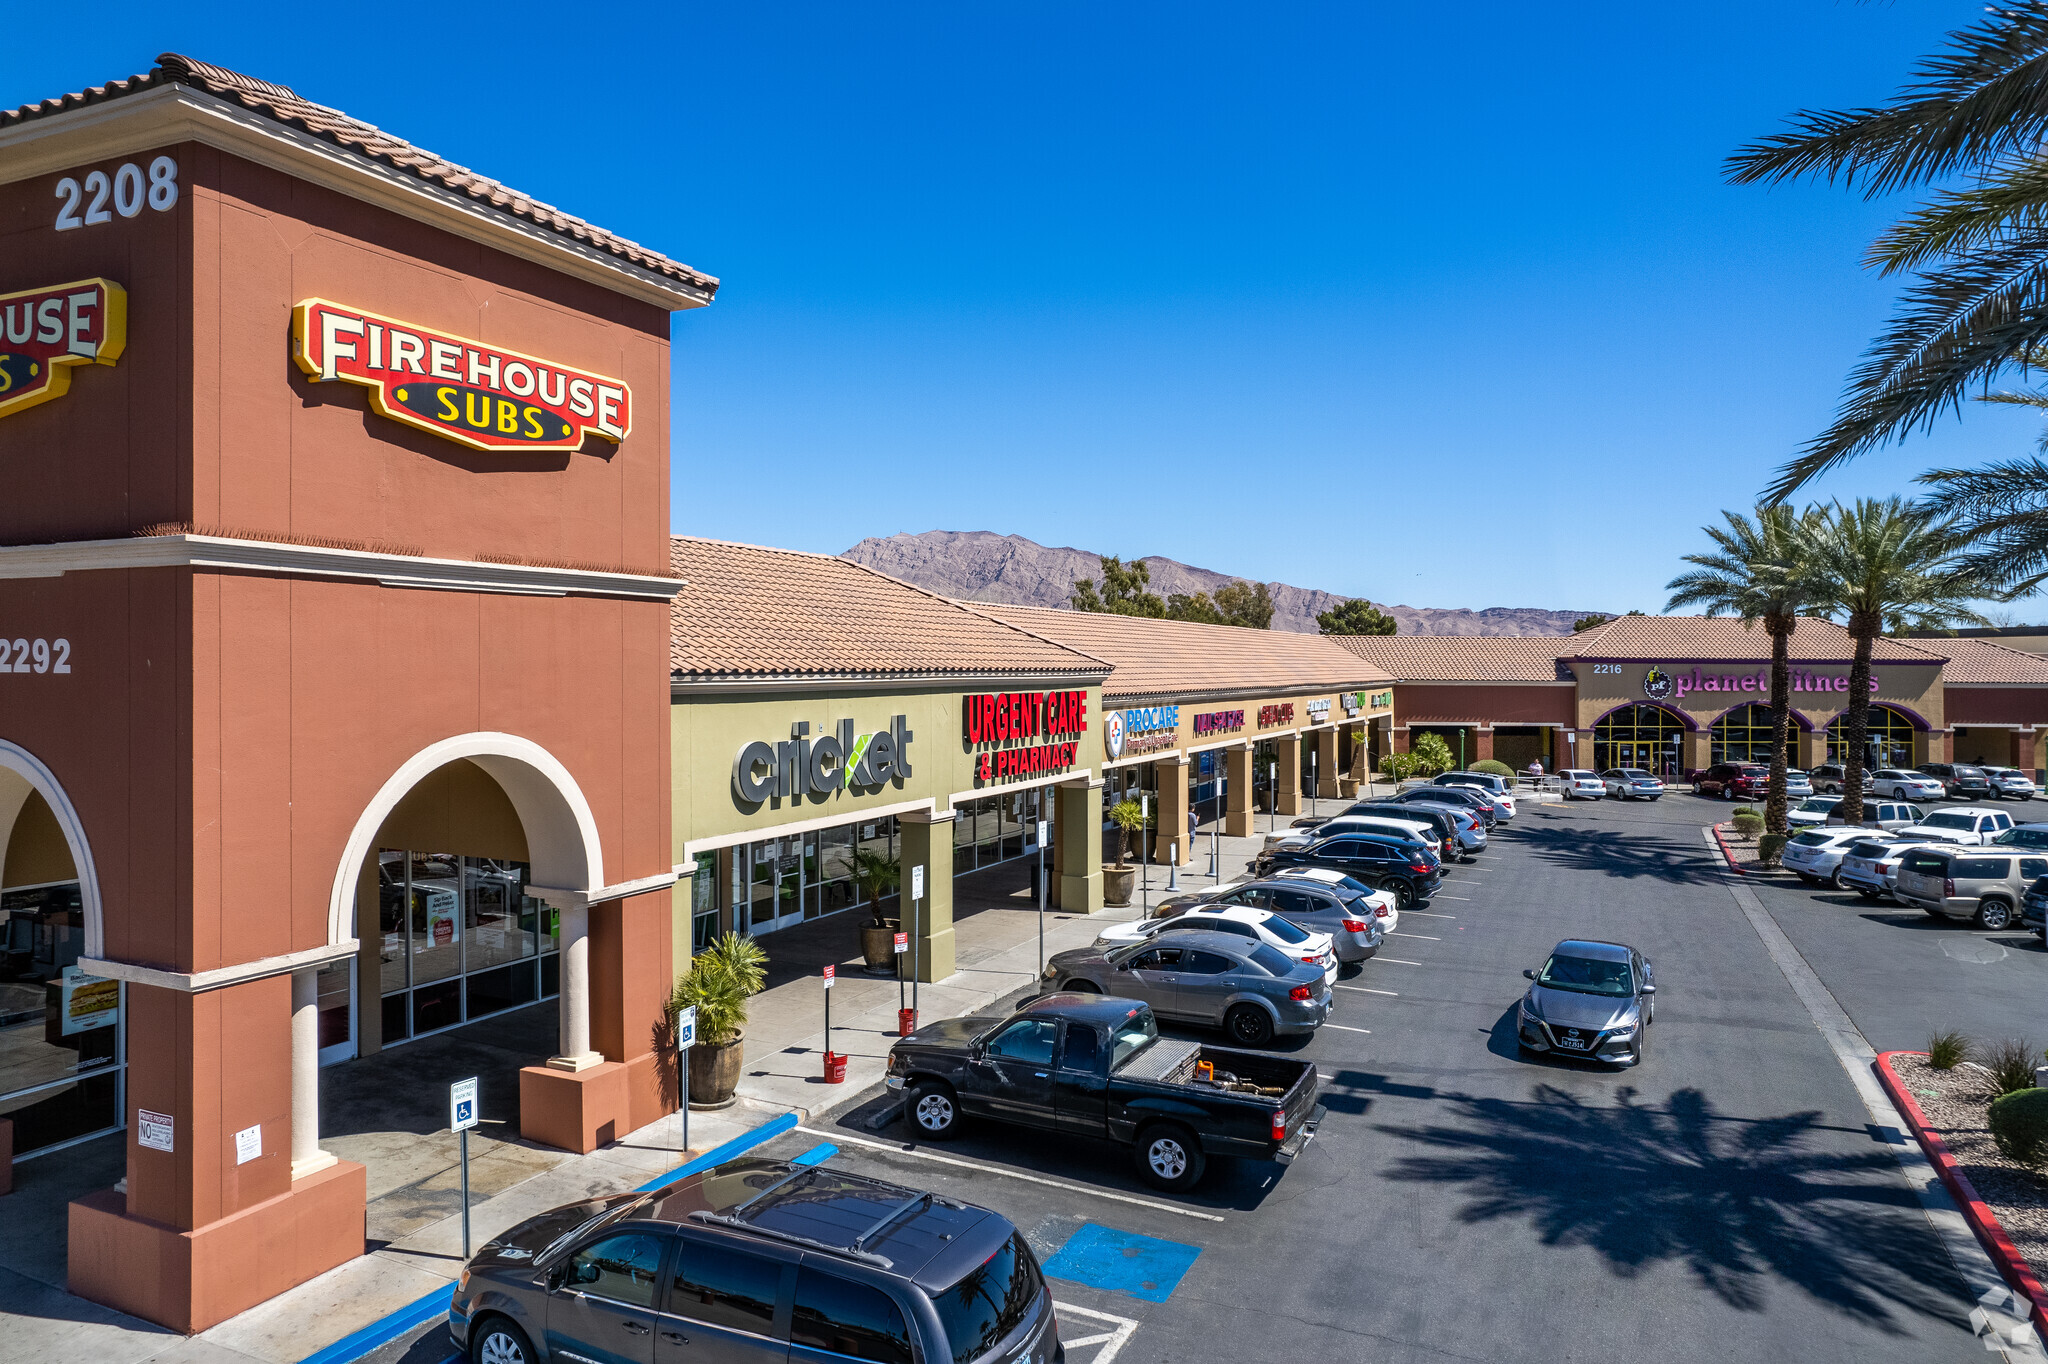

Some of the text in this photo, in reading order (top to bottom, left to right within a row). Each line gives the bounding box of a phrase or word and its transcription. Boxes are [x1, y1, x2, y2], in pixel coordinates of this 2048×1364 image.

[55, 156, 179, 232] 2208
[0, 287, 98, 361] USE
[319, 311, 624, 443] FIREHOUSE
[436, 386, 545, 440] SUBS
[0, 638, 71, 674] 2292
[1593, 664, 1622, 674] 2216
[1650, 680, 1667, 691] pf
[1675, 667, 1880, 698] planet itnes
[964, 690, 1087, 744] URGENT CARE
[1126, 705, 1179, 733] PROCARE
[733, 714, 914, 804] cricket
[977, 741, 1079, 781] & PHARMACY
[412, 851, 434, 863] UBS
[140, 1121, 152, 1139] NO
